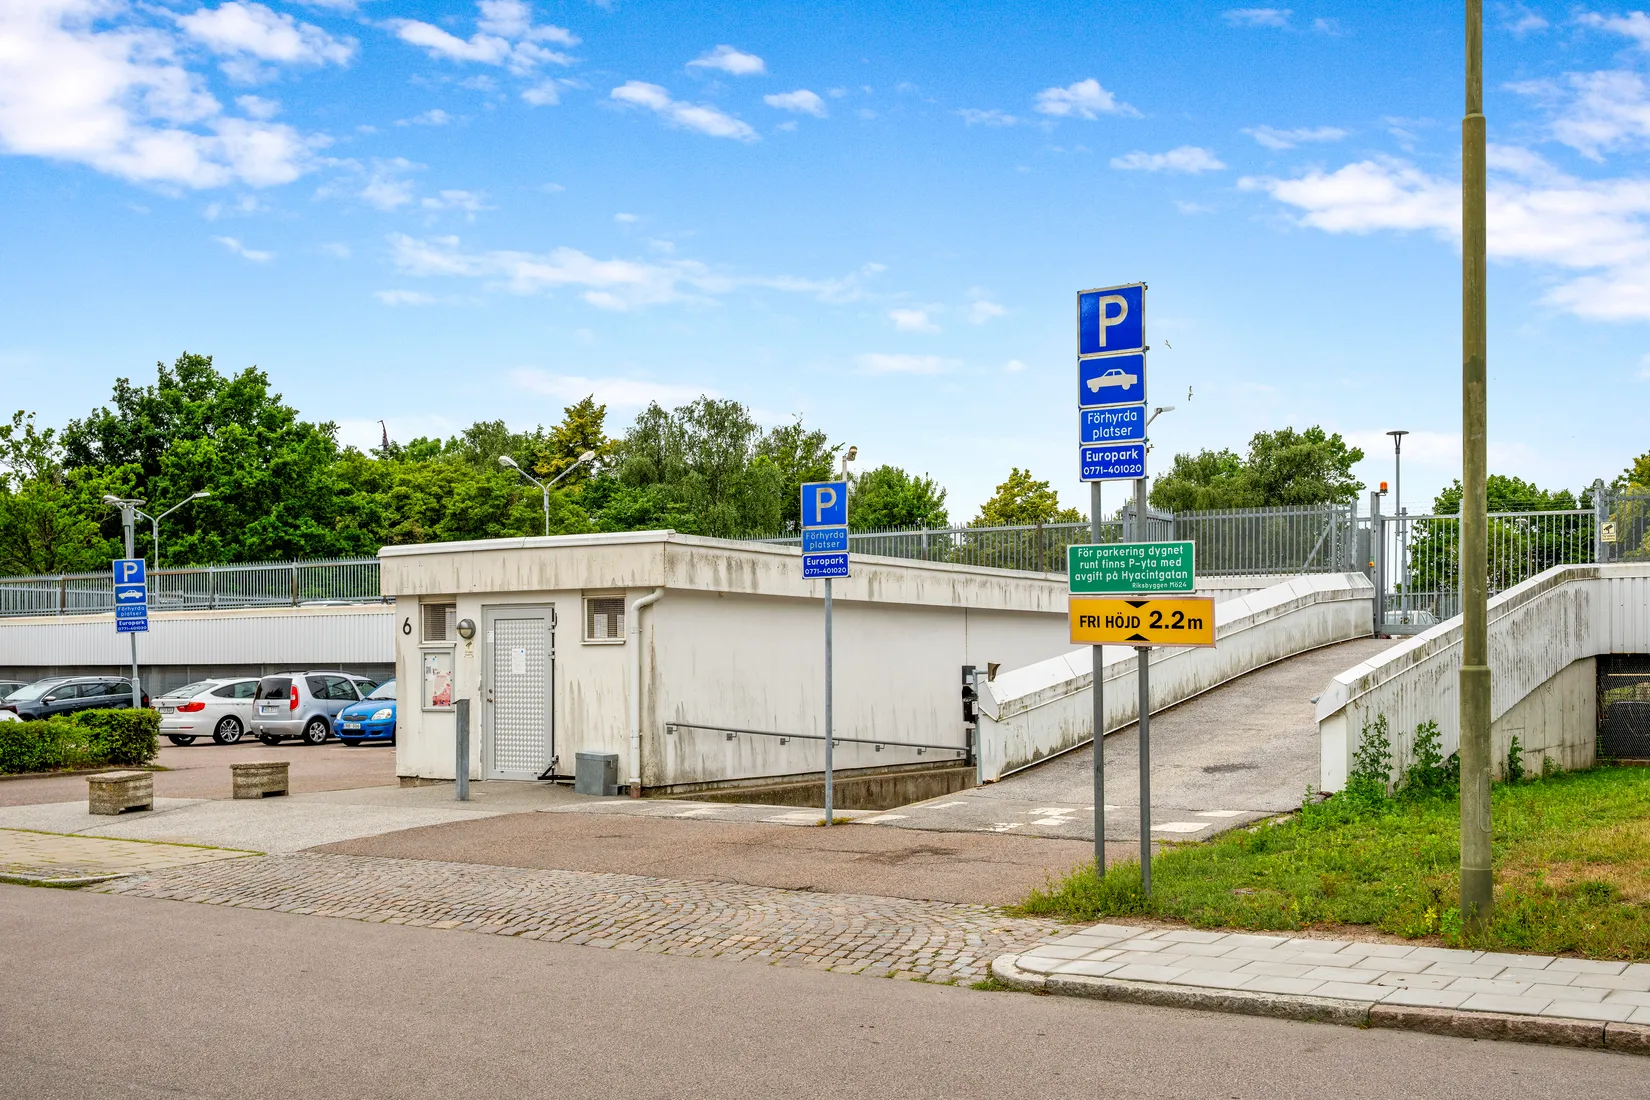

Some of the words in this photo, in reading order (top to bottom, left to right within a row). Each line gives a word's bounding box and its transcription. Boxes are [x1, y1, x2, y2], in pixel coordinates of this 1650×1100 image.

[1099, 294, 1128, 347] P
[1087, 410, 1137, 426] Förhyrda
[1092, 425, 1133, 440] platser
[1086, 449, 1139, 463] Europark
[1083, 464, 1142, 475] 0771-401020
[816, 487, 837, 523] P
[805, 531, 844, 541] Förhyrda
[810, 541, 840, 550] platser
[1078, 548, 1093, 557] För
[1096, 546, 1145, 559] parkering
[1148, 545, 1184, 557] dygnet
[806, 556, 844, 566] Europark
[1080, 560, 1099, 569] runt
[1101, 558, 1126, 568] finns
[1129, 558, 1157, 570] P-yta
[1160, 557, 1182, 567] med
[123, 561, 138, 582] P
[805, 567, 846, 575] 0771-401020
[1075, 572, 1103, 583] avgift
[1106, 571, 1118, 582] på
[1121, 570, 1188, 582] Hyacintgatan
[1132, 582, 1168, 590] Riksbyggen
[403, 617, 412, 636] 6
[1079, 615, 1101, 628] FRI
[1105, 612, 1141, 629] HÖJD
